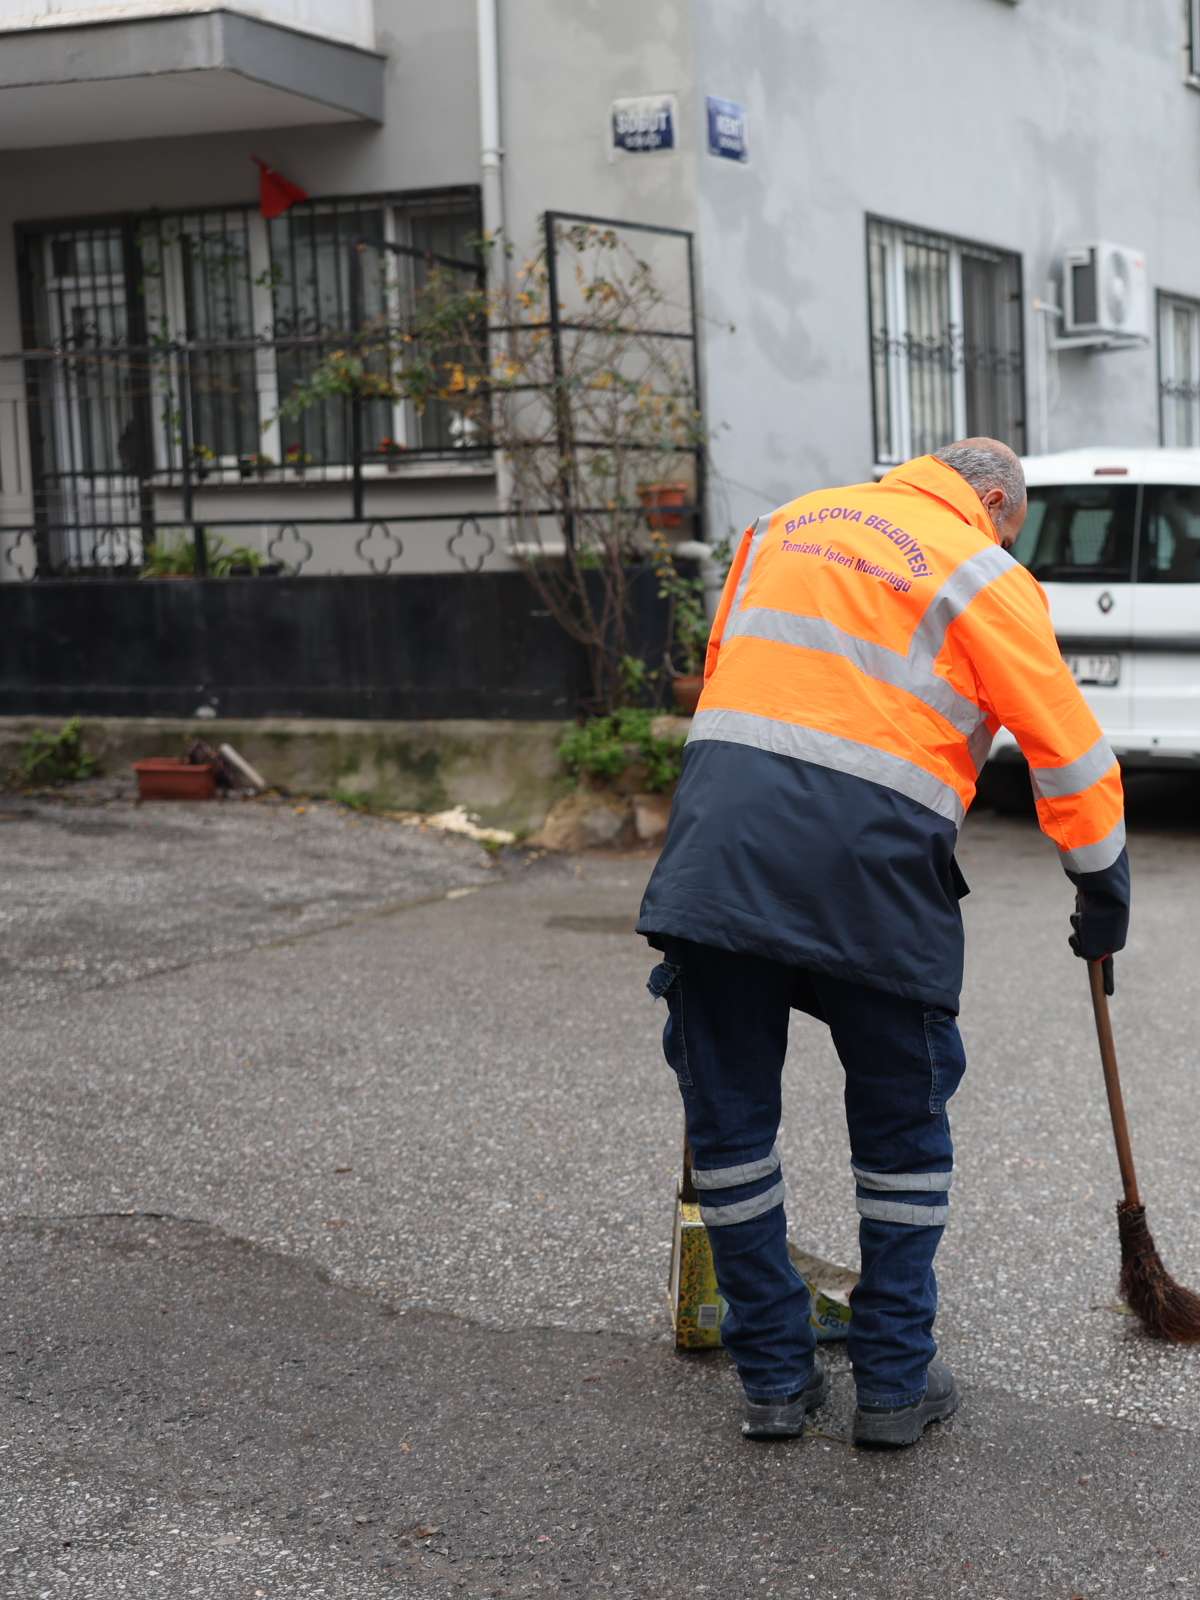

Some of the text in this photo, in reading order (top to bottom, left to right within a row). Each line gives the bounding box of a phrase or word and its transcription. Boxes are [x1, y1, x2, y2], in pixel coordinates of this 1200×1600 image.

[780, 540, 912, 593] Temizlik İşleri Müdürlüğü
[784, 507, 933, 578] BALÇOVA BELEDİYESİ
